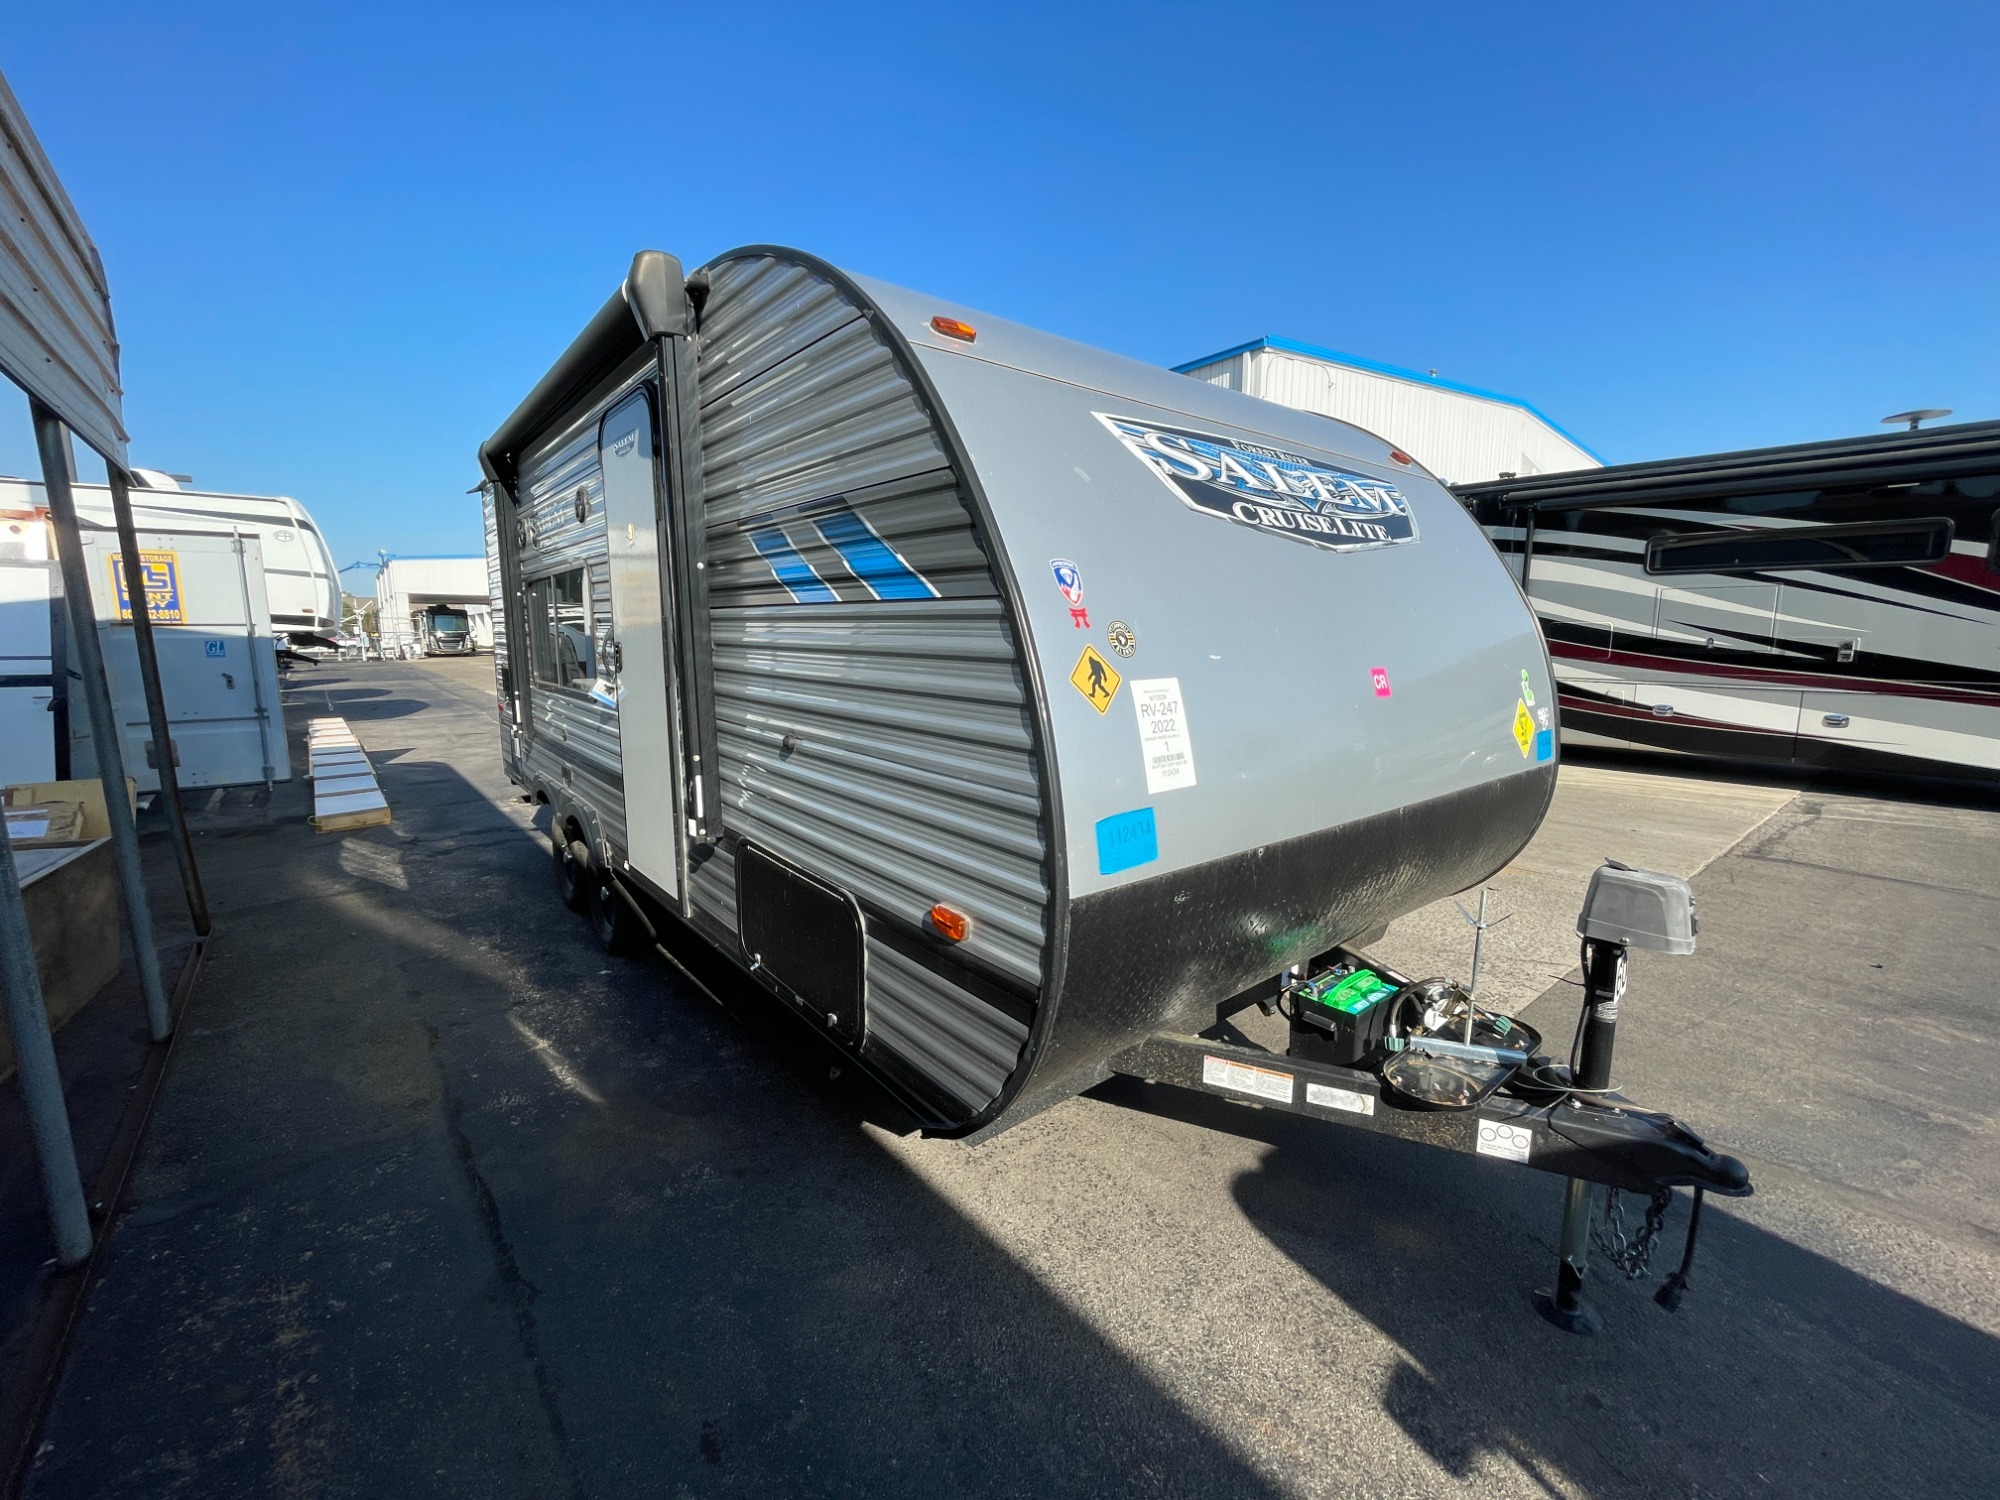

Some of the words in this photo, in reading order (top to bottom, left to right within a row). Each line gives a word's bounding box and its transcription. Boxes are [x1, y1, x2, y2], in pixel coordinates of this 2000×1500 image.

[1230, 440, 1277, 458] FOREST
[1275, 450, 1313, 467] RIVER
[1143, 431, 1408, 517] SALEM
[1232, 501, 1338, 534] CRUISE
[1332, 517, 1394, 541] LITE
[140, 554, 173, 563] STORAGE
[122, 609, 180, 619] 802-8810
[206, 641, 224, 653] GL
[1373, 674, 1388, 690] CR
[1140, 700, 1178, 718] RV-247
[1150, 718, 1176, 734] 2022
[1164, 740, 1170, 752] 1
[1107, 819, 1151, 848] 112434
